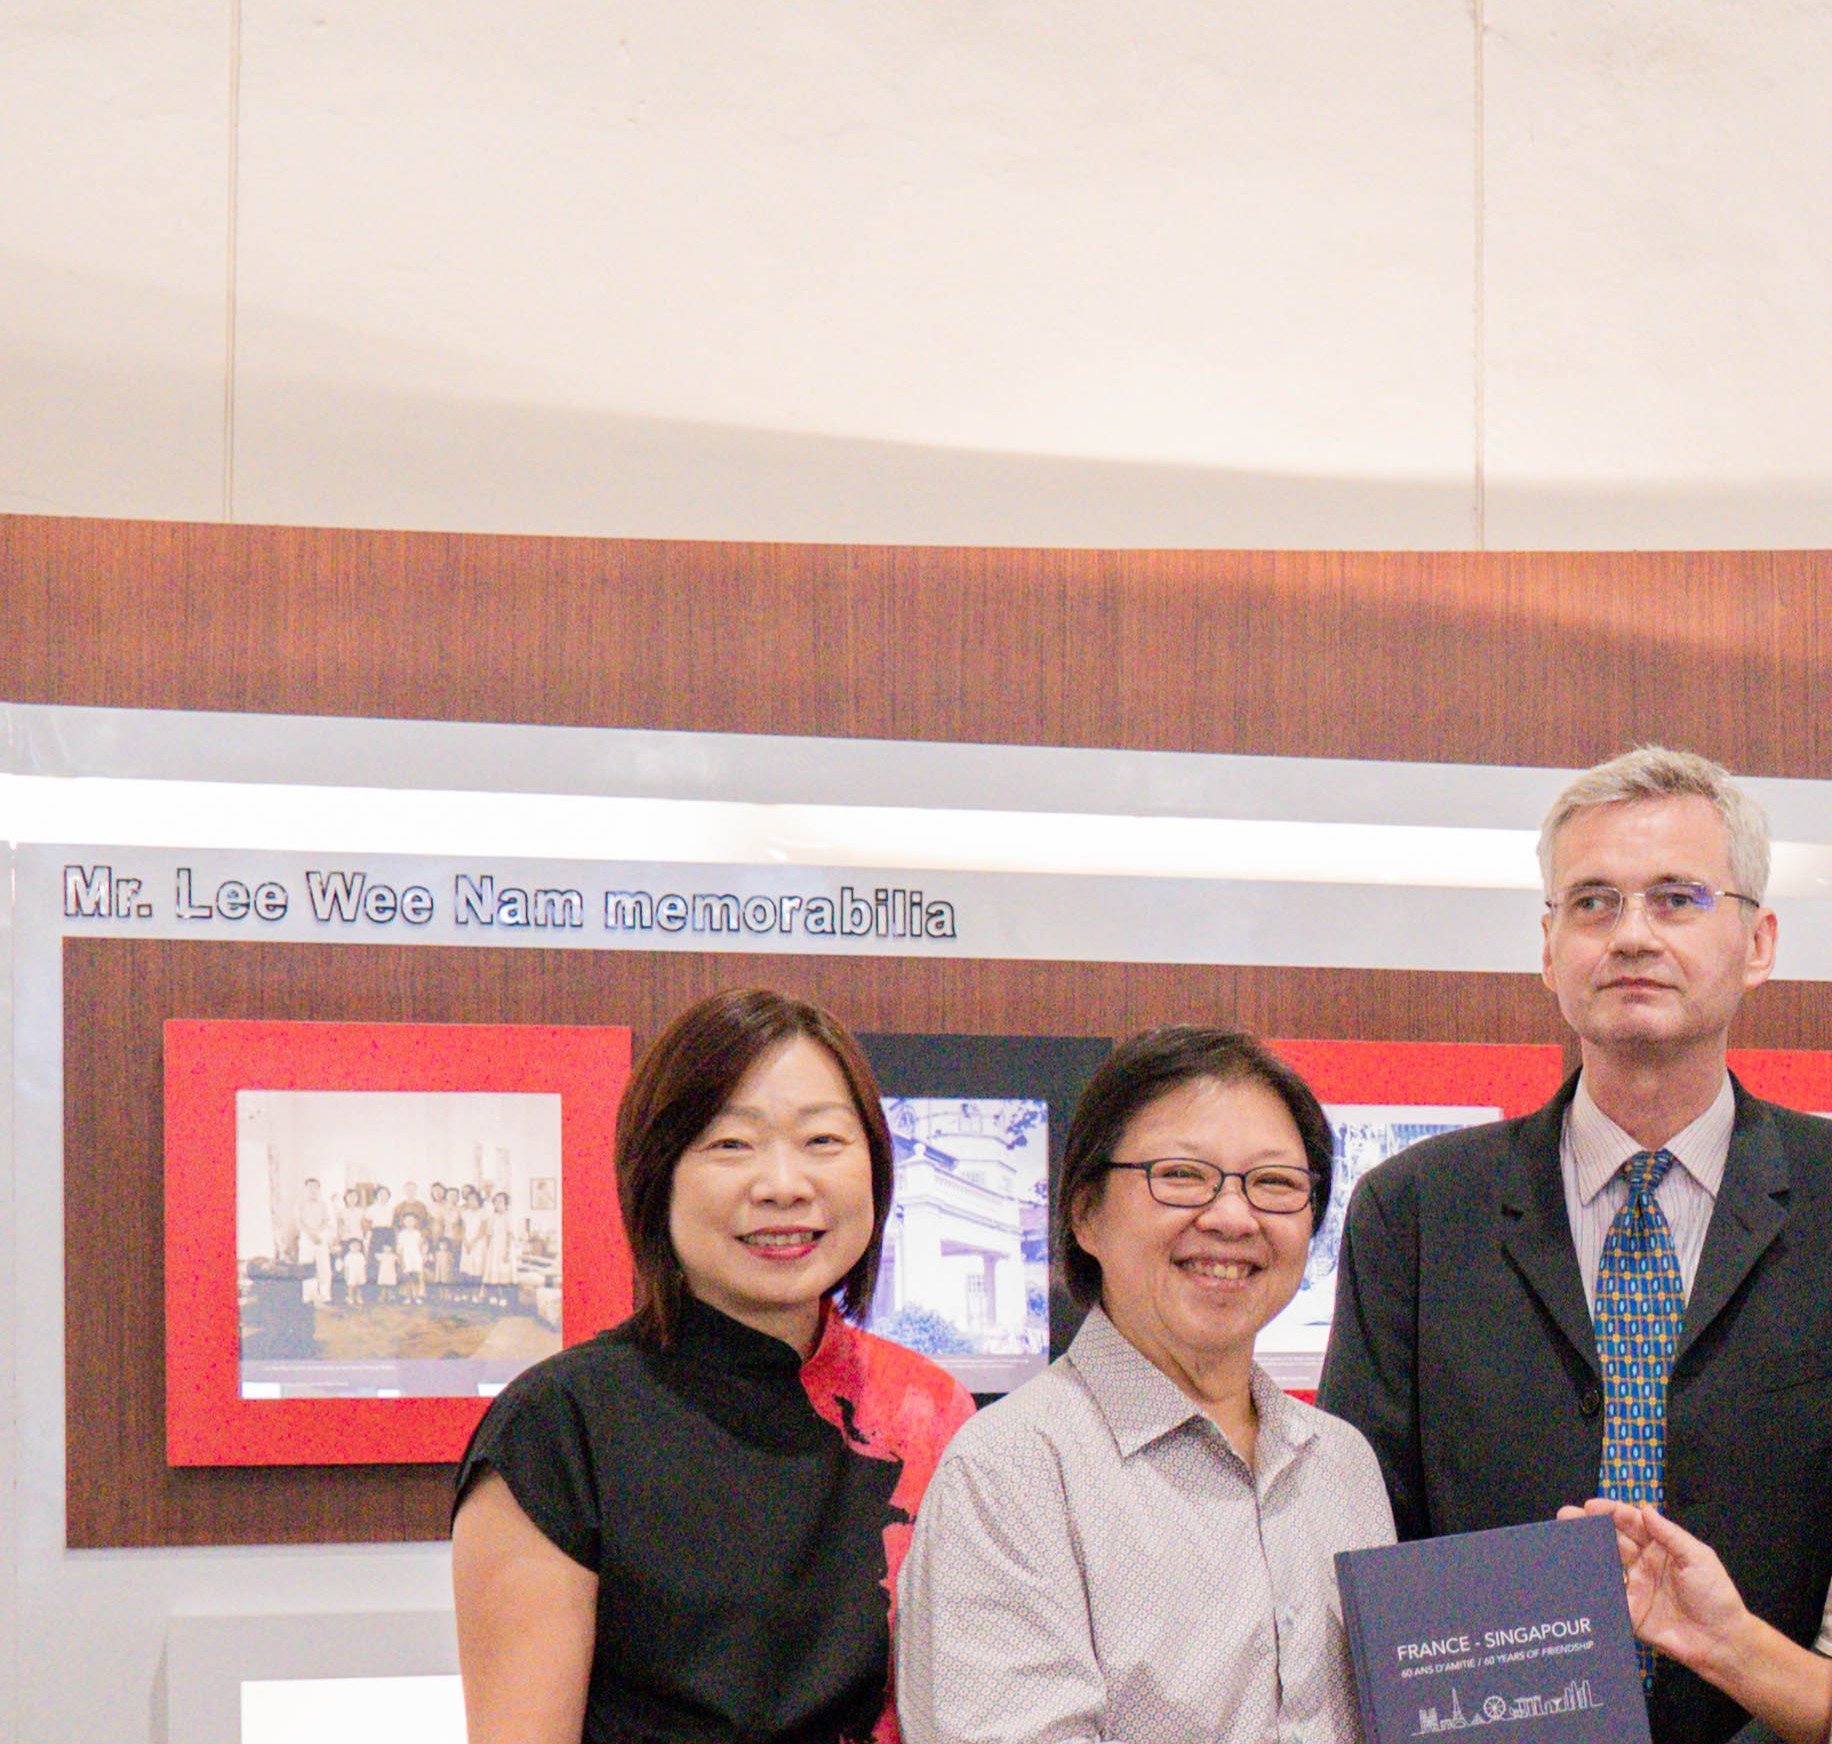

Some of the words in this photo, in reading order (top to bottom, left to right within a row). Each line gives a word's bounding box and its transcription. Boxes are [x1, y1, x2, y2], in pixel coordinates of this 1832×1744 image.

[62, 865, 153, 918] Mr.
[174, 867, 288, 921] Lee
[305, 871, 434, 924] Wee
[455, 875, 584, 928] Nam
[605, 886, 958, 939] memorabilia
[1397, 1636, 1470, 1661] FRANCE
[1484, 1617, 1592, 1648] SINGAPOUR
[1414, 1665, 1434, 1677] ANS
[1497, 1652, 1525, 1664] YEARS
[1526, 1648, 1539, 1659] OF
[1541, 1640, 1594, 1657] FRIENDSHIP
